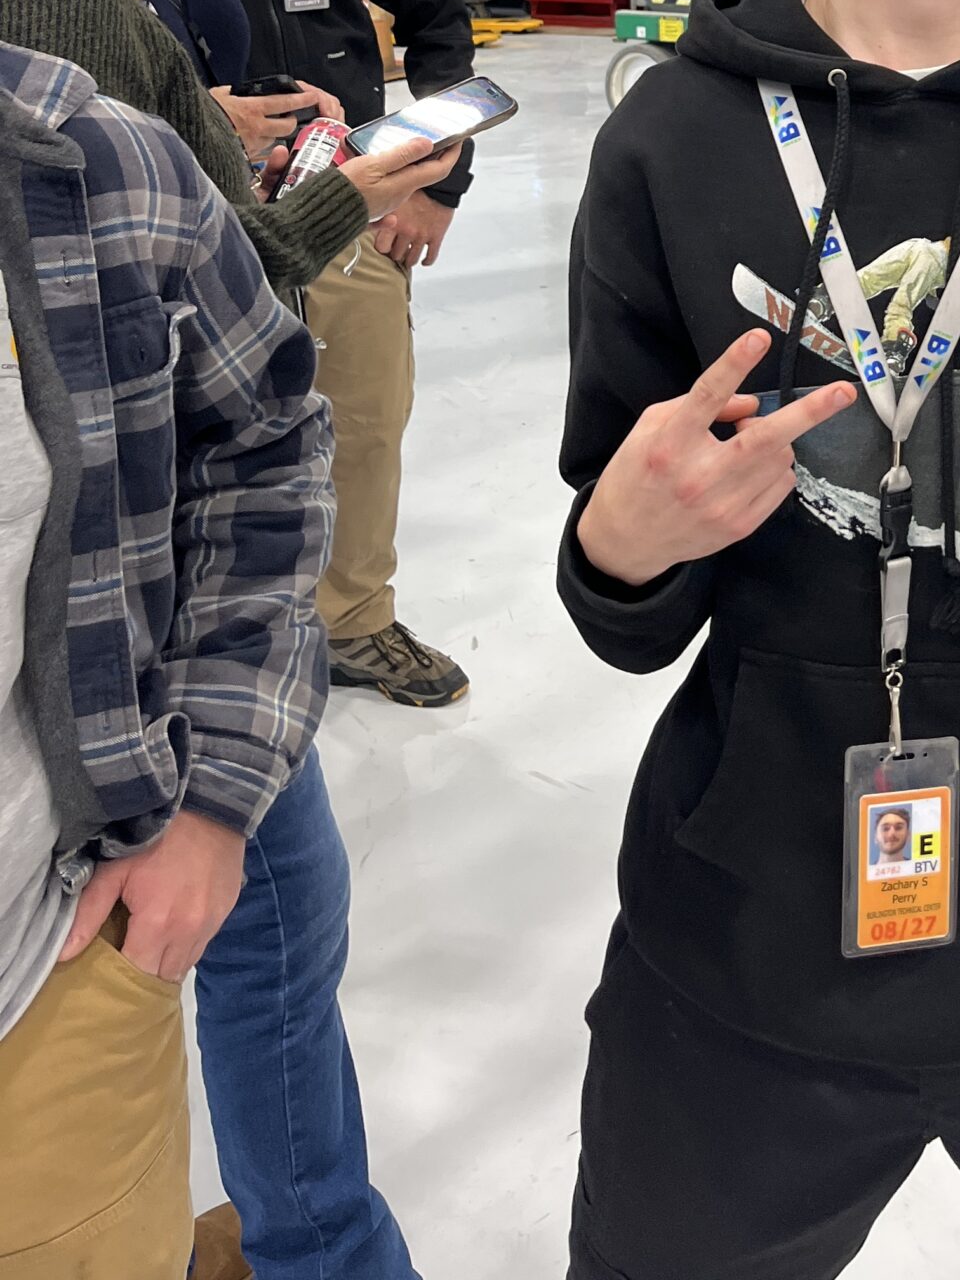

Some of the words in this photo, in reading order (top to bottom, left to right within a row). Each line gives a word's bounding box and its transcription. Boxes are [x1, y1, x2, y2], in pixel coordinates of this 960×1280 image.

[920, 833, 933, 856] E
[914, 860, 938, 873] BTV
[881, 880, 919, 892] Zachary
[921, 877, 928, 887] S
[892, 893, 917, 904] Perry
[870, 915, 937, 942] 08/27
